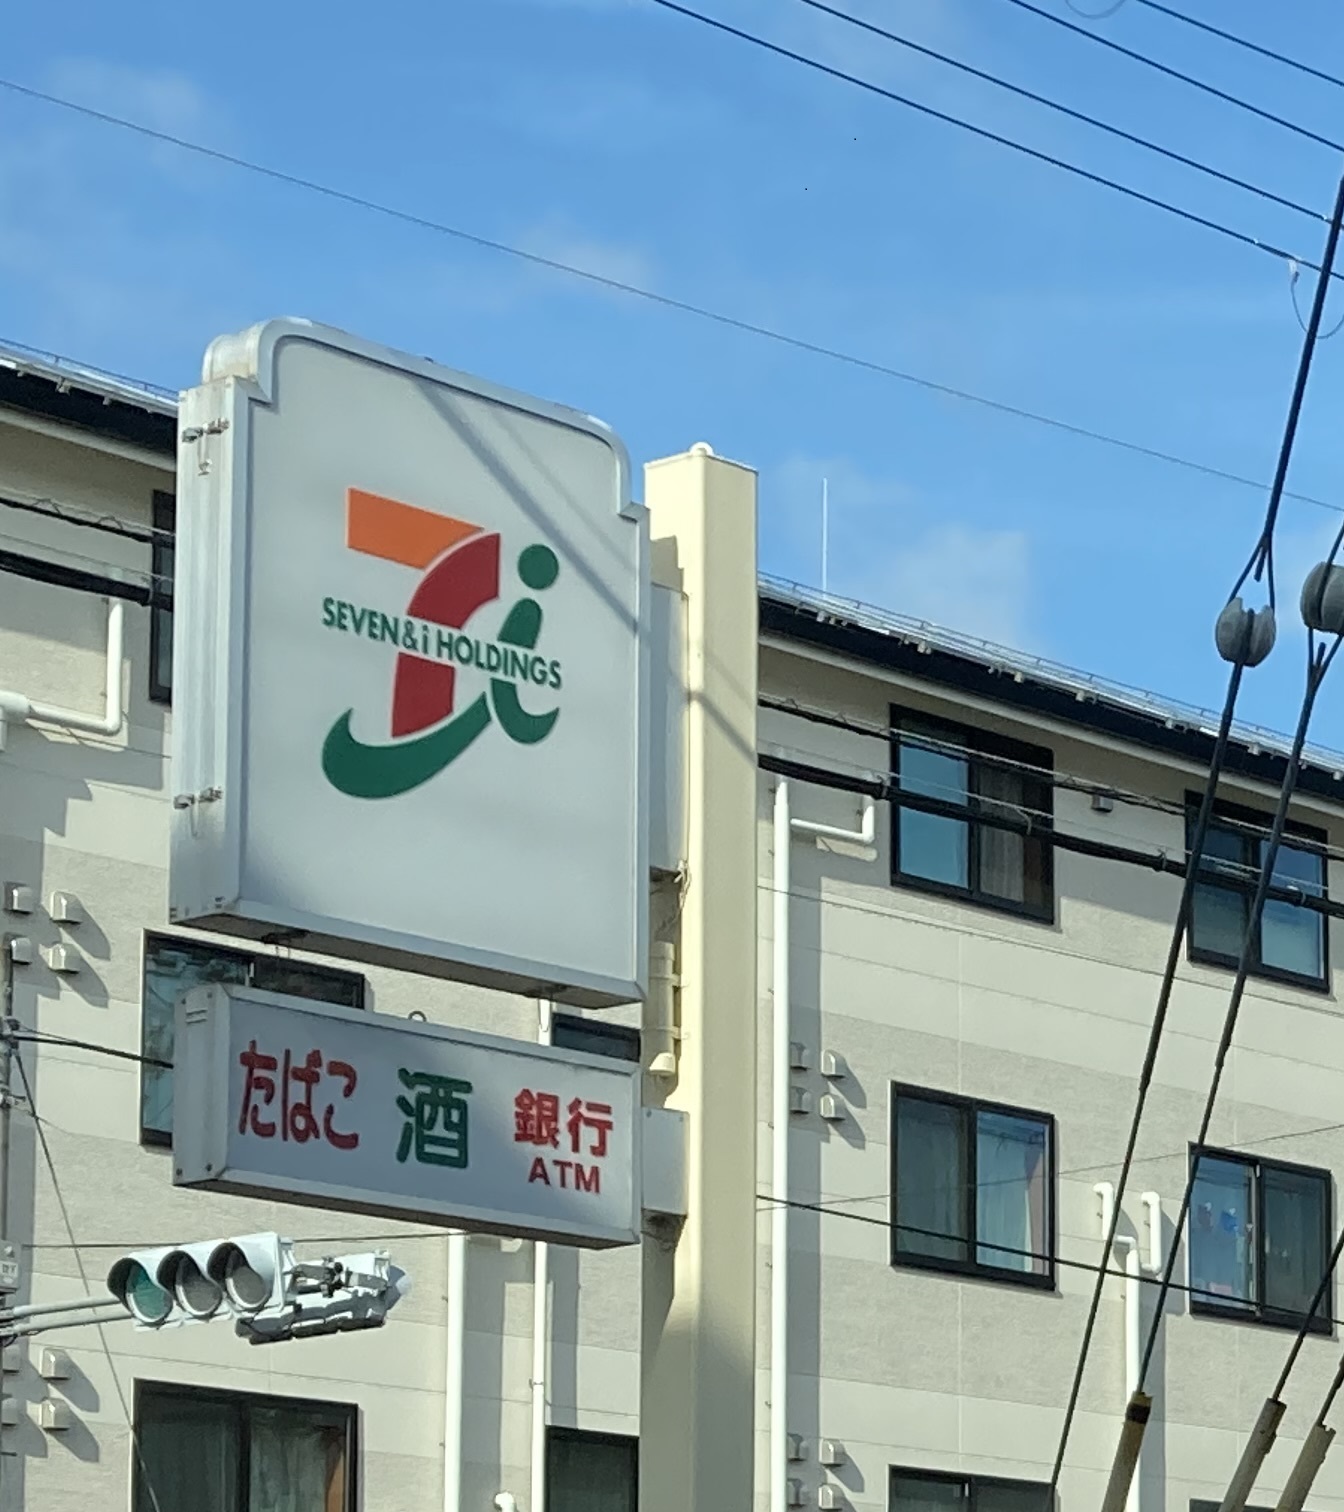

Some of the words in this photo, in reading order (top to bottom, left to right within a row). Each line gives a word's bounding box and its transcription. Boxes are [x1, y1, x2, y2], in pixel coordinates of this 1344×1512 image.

[436, 628, 563, 691] HOLDINGS
[238, 1039, 360, 1151] たばこ
[396, 1067, 474, 1170] 酒
[513, 1087, 614, 1158] 銀行
[527, 1156, 601, 1195] ATM
